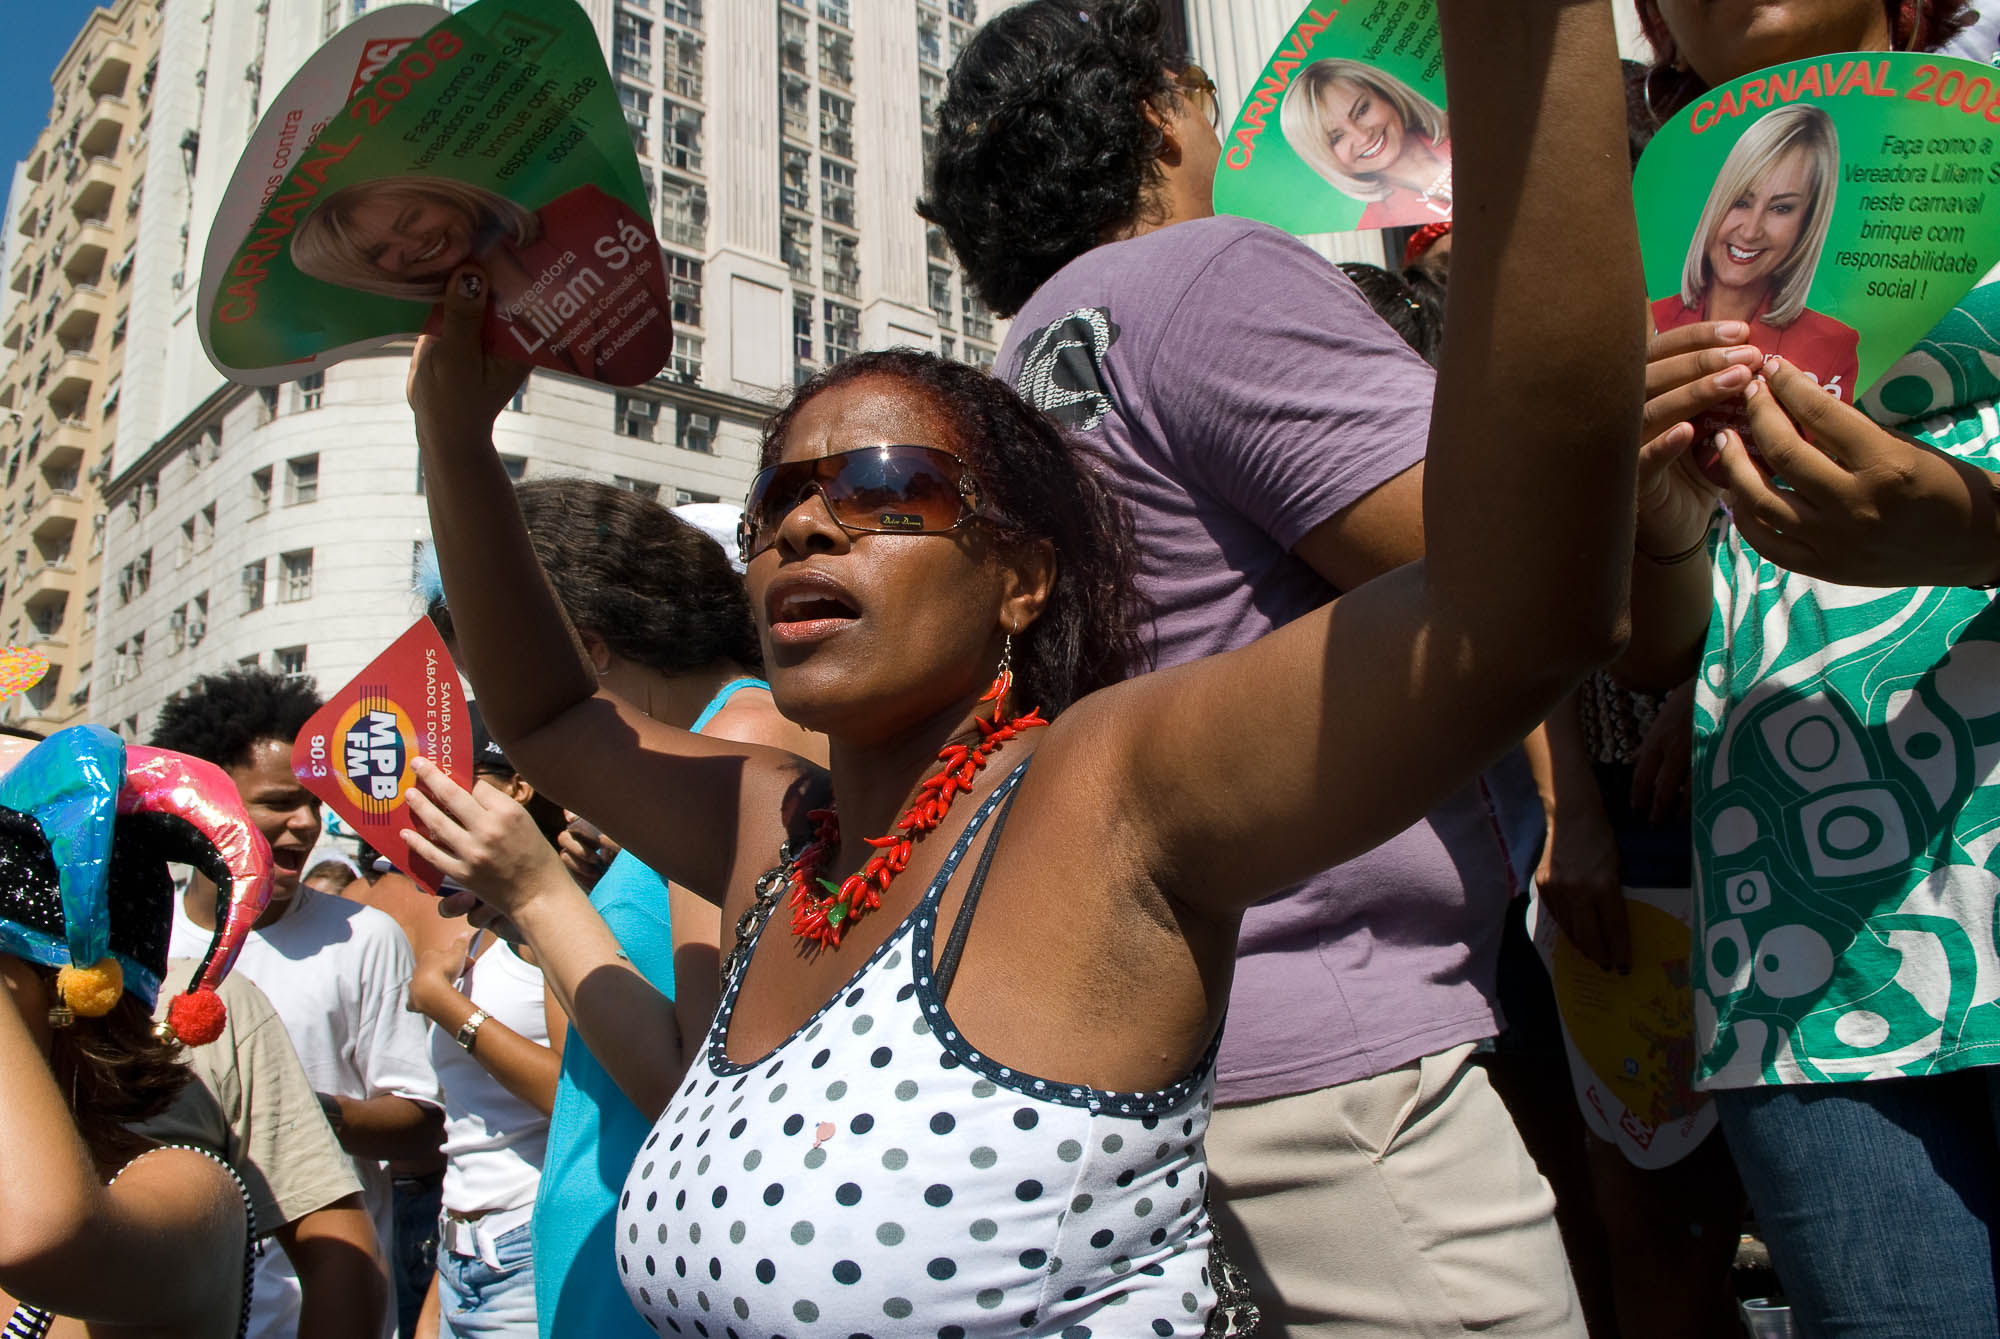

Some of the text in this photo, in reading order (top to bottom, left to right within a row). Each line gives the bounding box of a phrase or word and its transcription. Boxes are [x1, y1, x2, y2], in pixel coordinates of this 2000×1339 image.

[1361, 1, 1410, 60] Vereadora
[1393, 21, 1419, 56] neste
[403, 51, 488, 144] Faça como a
[453, 61, 542, 159] neste carnaval
[478, 78, 561, 159] brinque com
[1226, 9, 1338, 171] CARNAVAL
[1690, 60, 2000, 135] CARNAVAL 2008
[272, 109, 303, 169] contra
[407, 103, 474, 171] Vereadora
[496, 75, 598, 180] responsabilidade
[547, 124, 588, 165] social
[1880, 134, 1993, 160] Faça como a
[218, 133, 363, 324] CARNAVAL
[351, 30, 464, 126] 2008
[1844, 163, 1928, 183] Vereadora
[1931, 161, 1984, 185] Liliam
[1859, 192, 1986, 215] neste carnaval
[1860, 219, 1966, 245] brinque com
[496, 250, 577, 323] Vereadora
[509, 218, 651, 355] Liliam Sá
[1835, 249, 1978, 275] responsabilidade
[1866, 276, 1917, 300] social
[551, 317, 592, 357] Presidente
[599, 271, 639, 311] Comissão
[578, 325, 610, 356] Direitos
[607, 316, 622, 329] da
[612, 306, 659, 349] Adolescente
[426, 648, 439, 766] SÁBADO E DOMI
[441, 682, 451, 733] SAMBA
[310, 734, 328, 778] 90.3
[347, 731, 369, 777] FM
[369, 709, 399, 800] MPB
